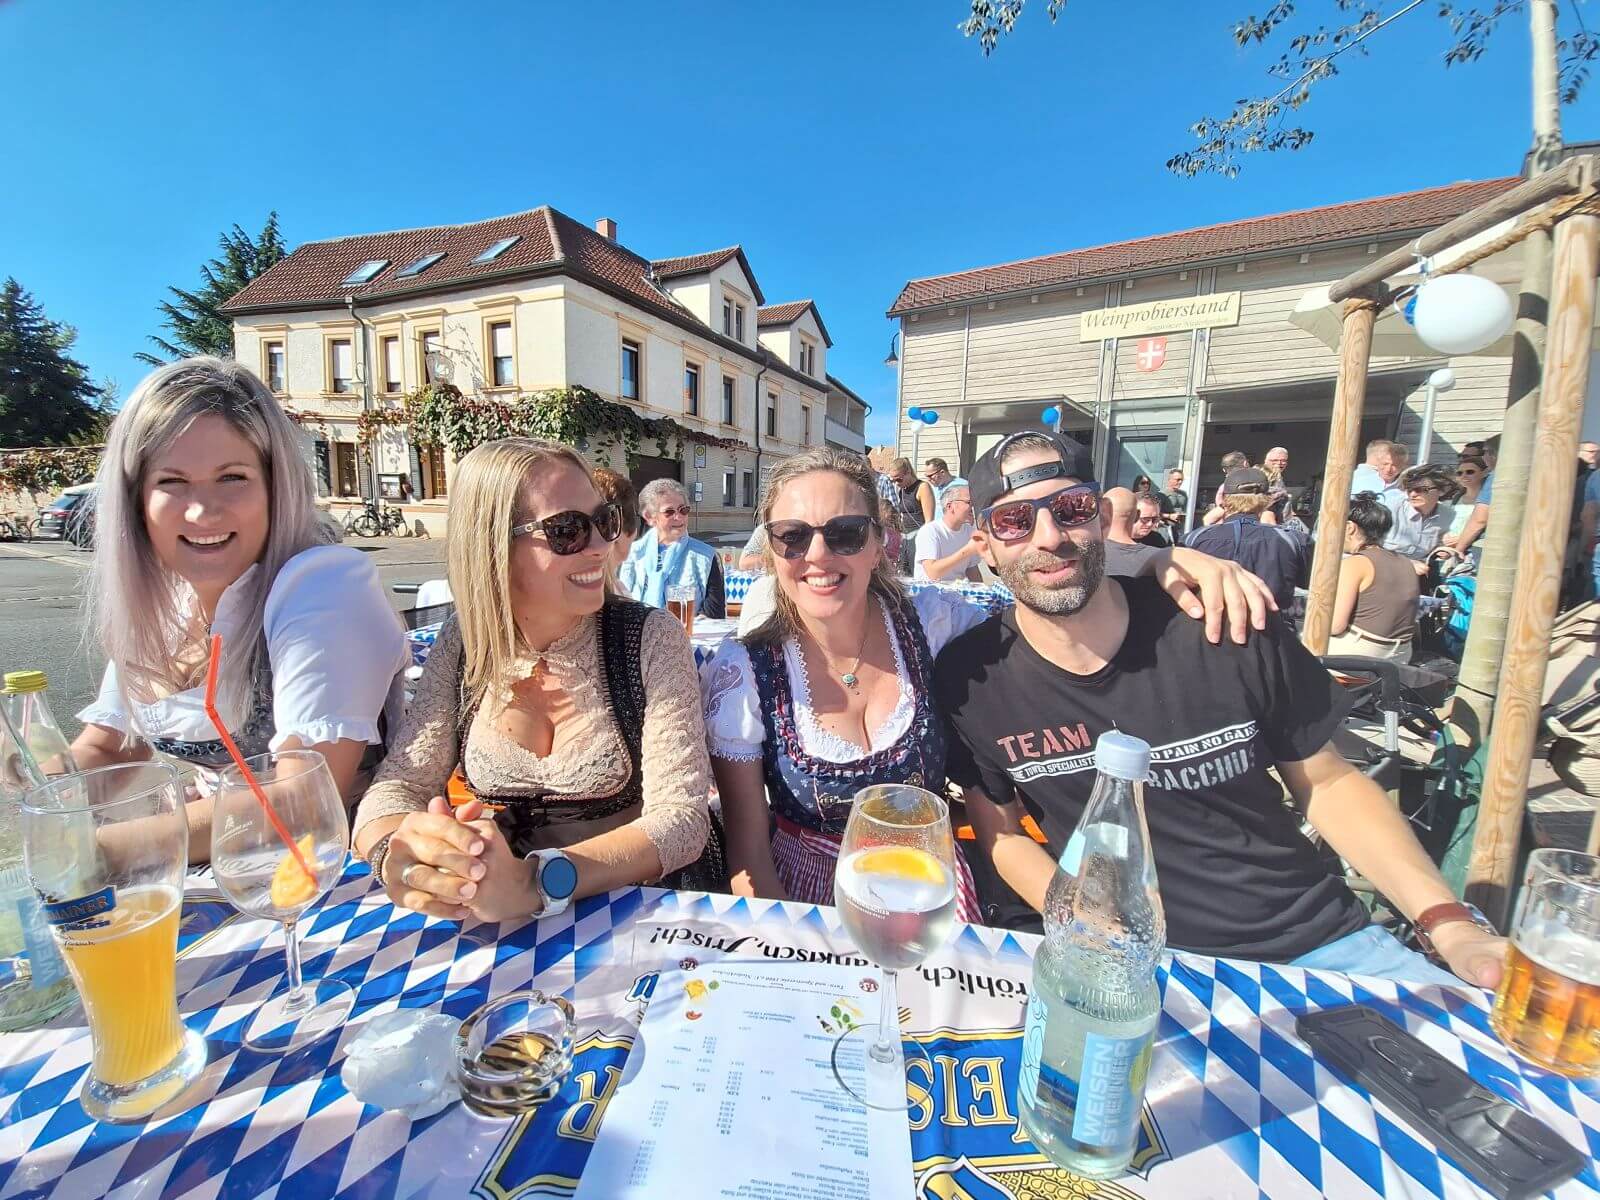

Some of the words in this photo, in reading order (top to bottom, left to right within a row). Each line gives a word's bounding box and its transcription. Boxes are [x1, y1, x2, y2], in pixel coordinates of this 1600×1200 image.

[1085, 292, 1235, 328] Weinprobierstand
[997, 723, 1092, 762] TEAM
[1162, 742, 1200, 759] PAIN
[1200, 735, 1222, 750] NO
[914, 965, 1029, 1001] röhlich,
[1081, 1042, 1113, 1137] WEISEN
